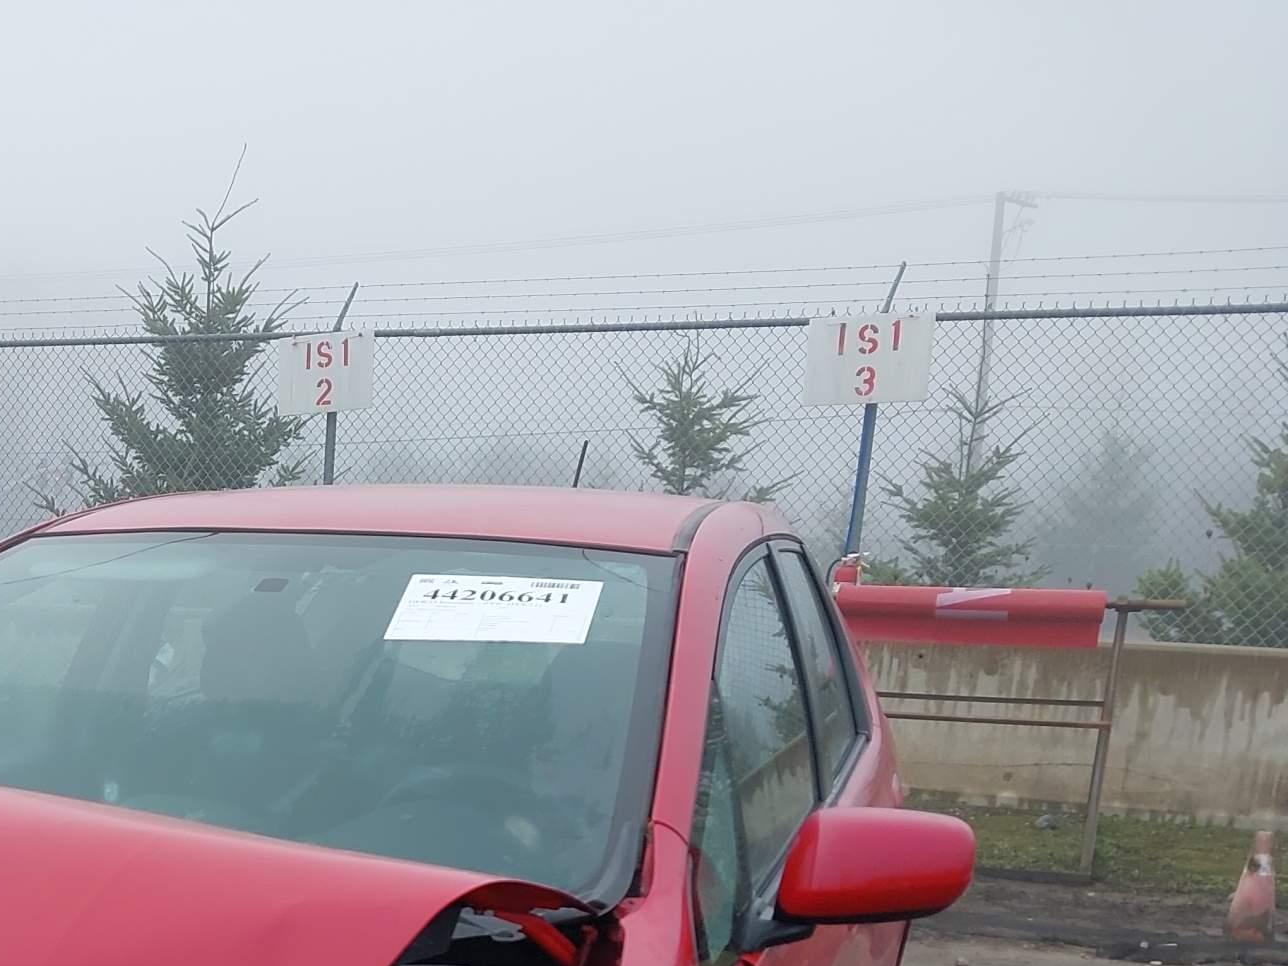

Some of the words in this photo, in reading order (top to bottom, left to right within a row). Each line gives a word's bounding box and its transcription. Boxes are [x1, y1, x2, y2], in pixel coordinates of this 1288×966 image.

[316, 378, 332, 405] 2
[855, 366, 876, 396] 3
[423, 588, 569, 604] 44206641
